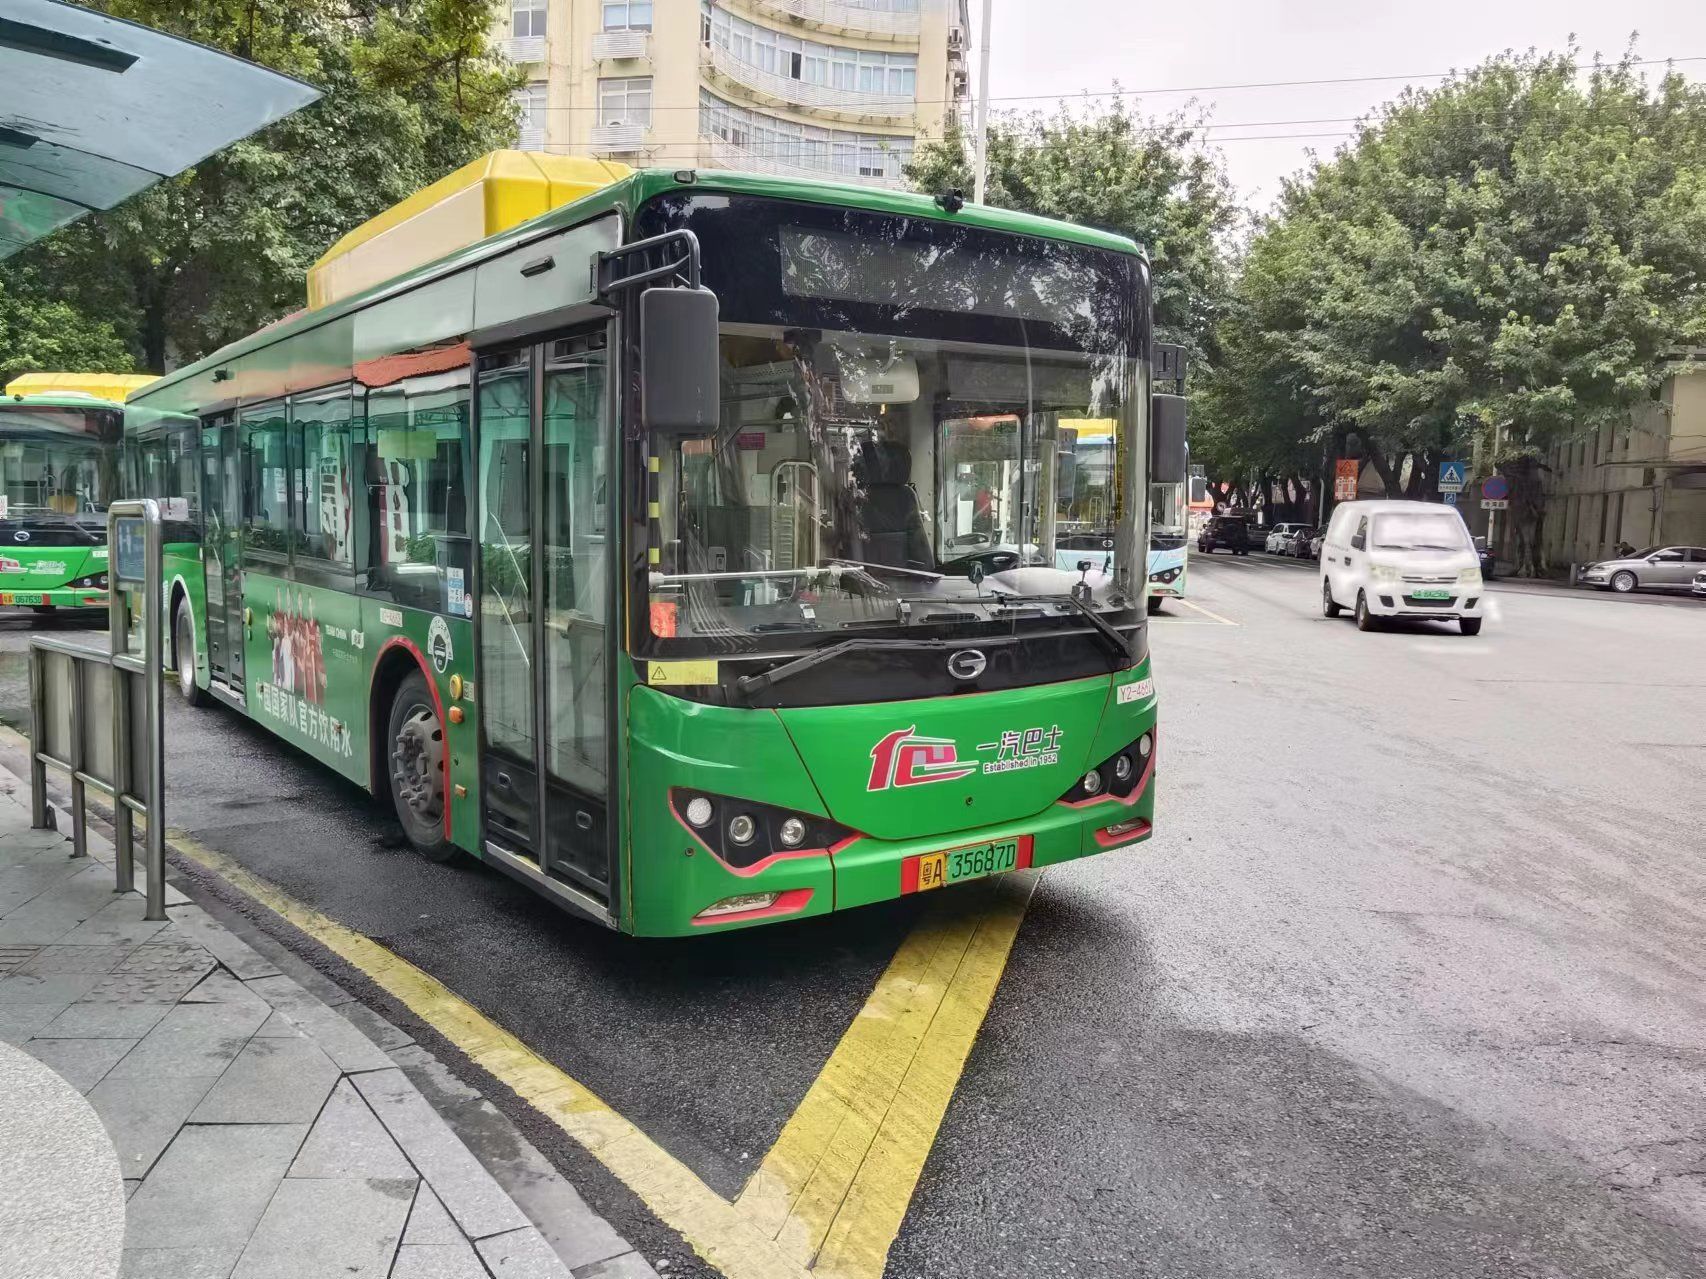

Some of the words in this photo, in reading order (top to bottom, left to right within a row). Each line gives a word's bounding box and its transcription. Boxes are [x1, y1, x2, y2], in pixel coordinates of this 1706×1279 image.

[976, 725, 1063, 759] 一汽巴士
[983, 758, 1029, 774] Established
[1040, 753, 1057, 765] 1952
[921, 858, 943, 885] 粤A
[951, 843, 1017, 879] 35687D
